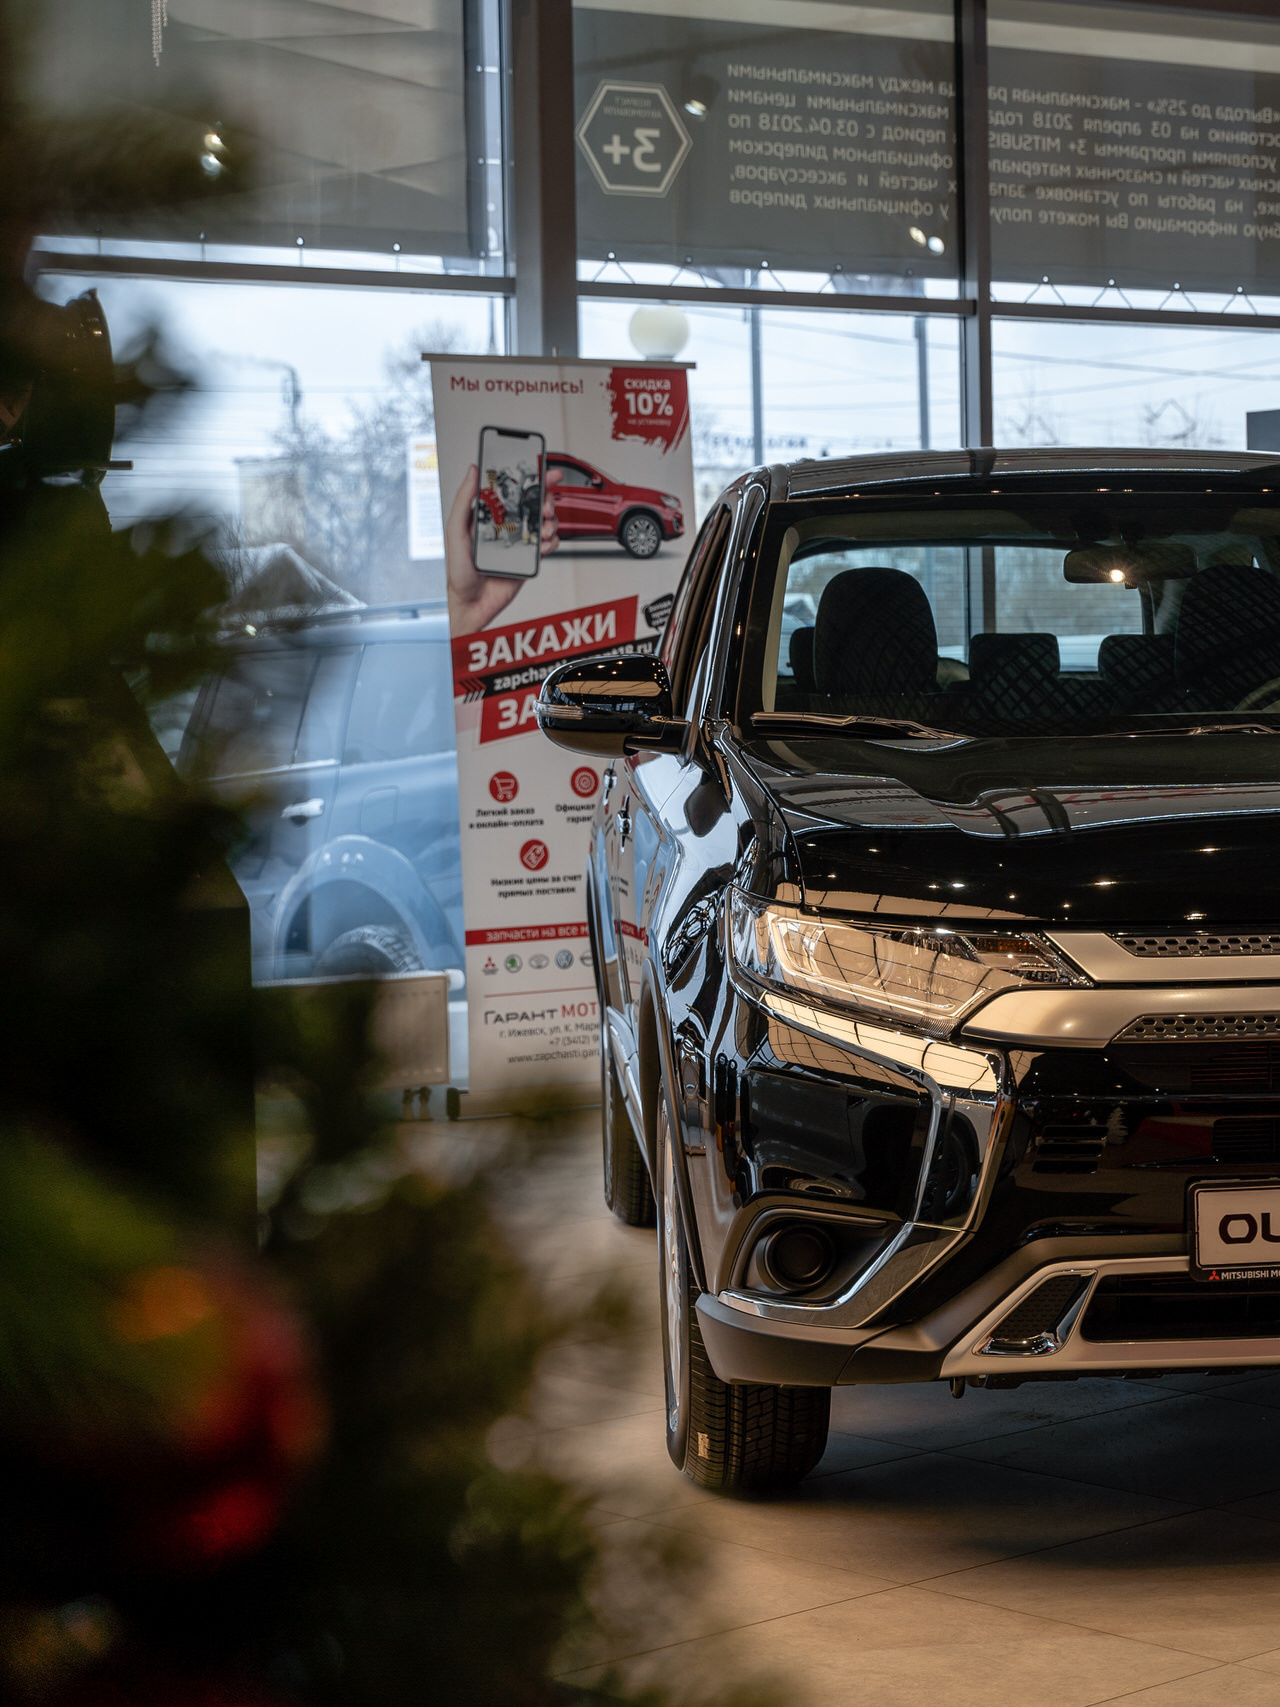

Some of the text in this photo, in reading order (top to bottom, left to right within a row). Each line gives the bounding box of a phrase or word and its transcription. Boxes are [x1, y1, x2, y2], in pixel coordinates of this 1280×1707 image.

[450, 376, 584, 396] Мы открылись!
[624, 378, 671, 391] скидка
[624, 392, 674, 416] 10%
[468, 610, 617, 672] ЗАКАЖИ
[1221, 1270, 1270, 1281] MITSUBISHI
